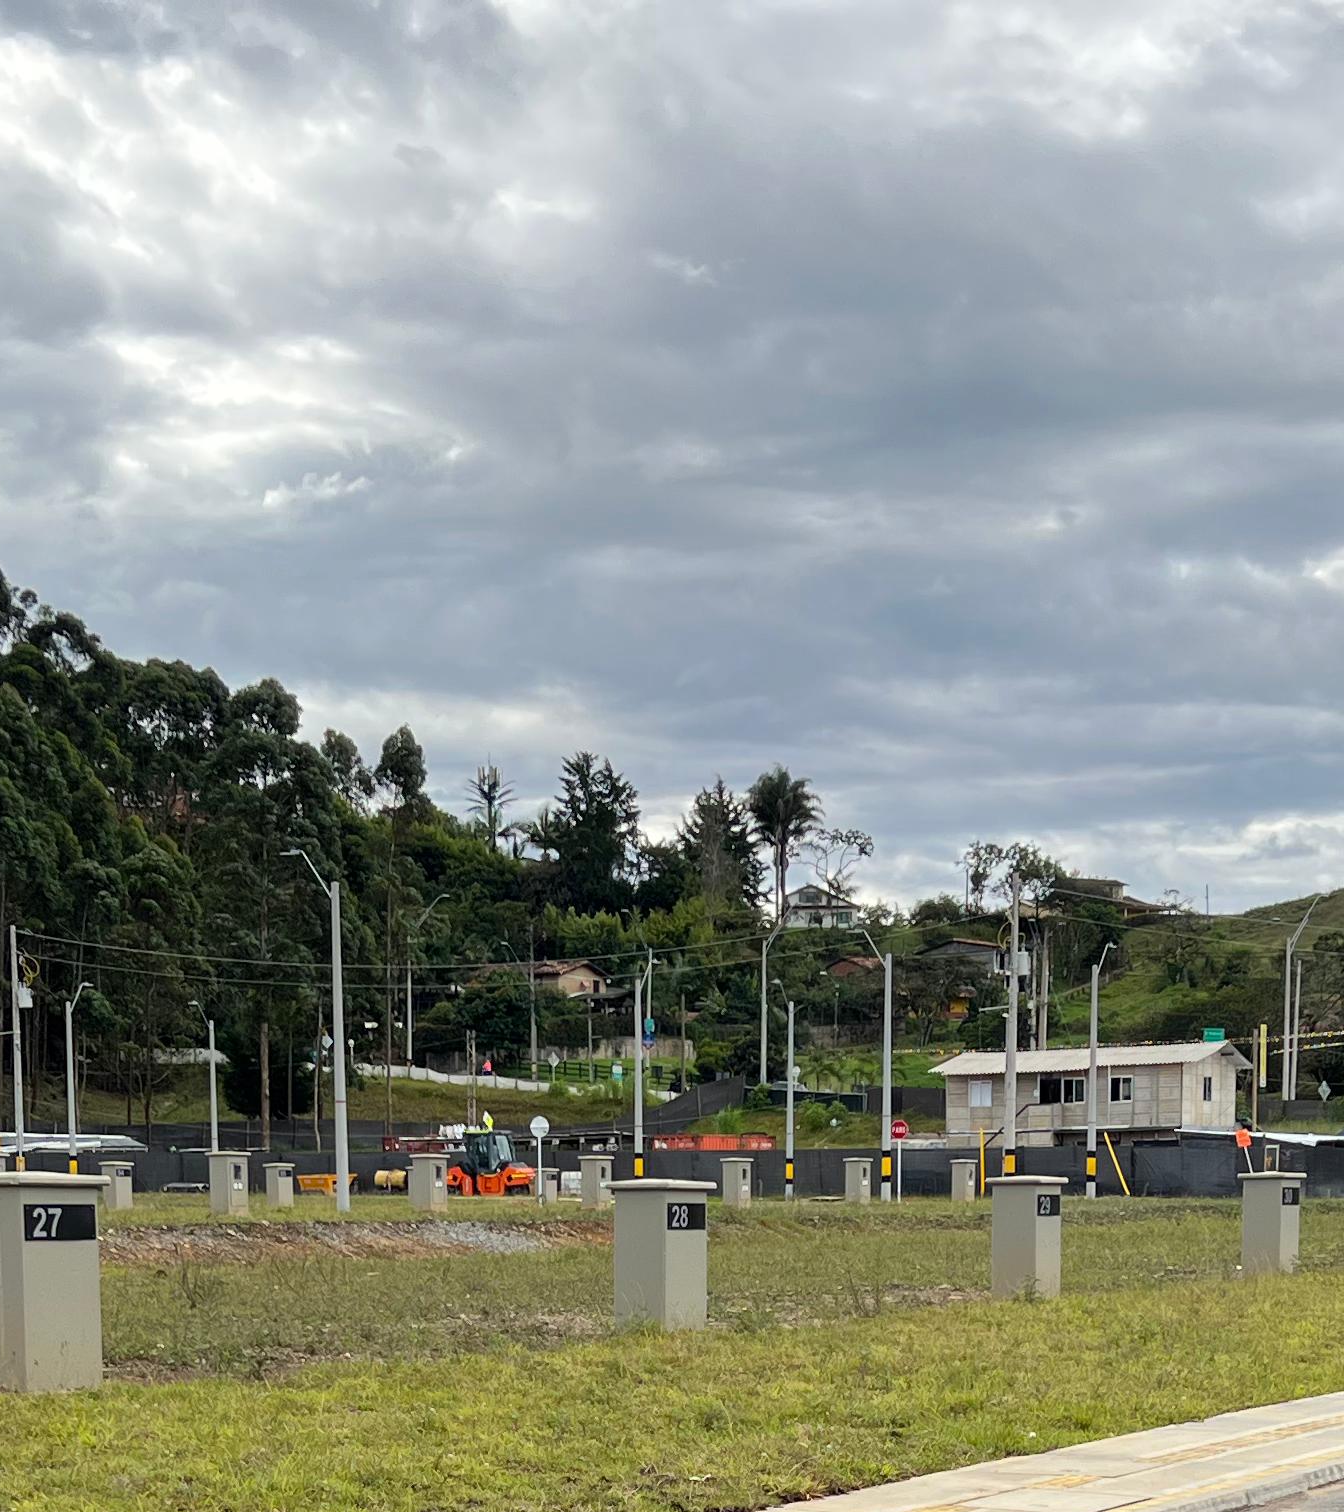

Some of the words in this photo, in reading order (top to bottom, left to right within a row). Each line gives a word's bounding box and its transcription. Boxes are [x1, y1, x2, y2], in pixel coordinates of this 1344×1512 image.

[671, 1205, 689, 1229] 28
[1039, 1195, 1051, 1215] 29
[32, 1207, 63, 1238] 27
